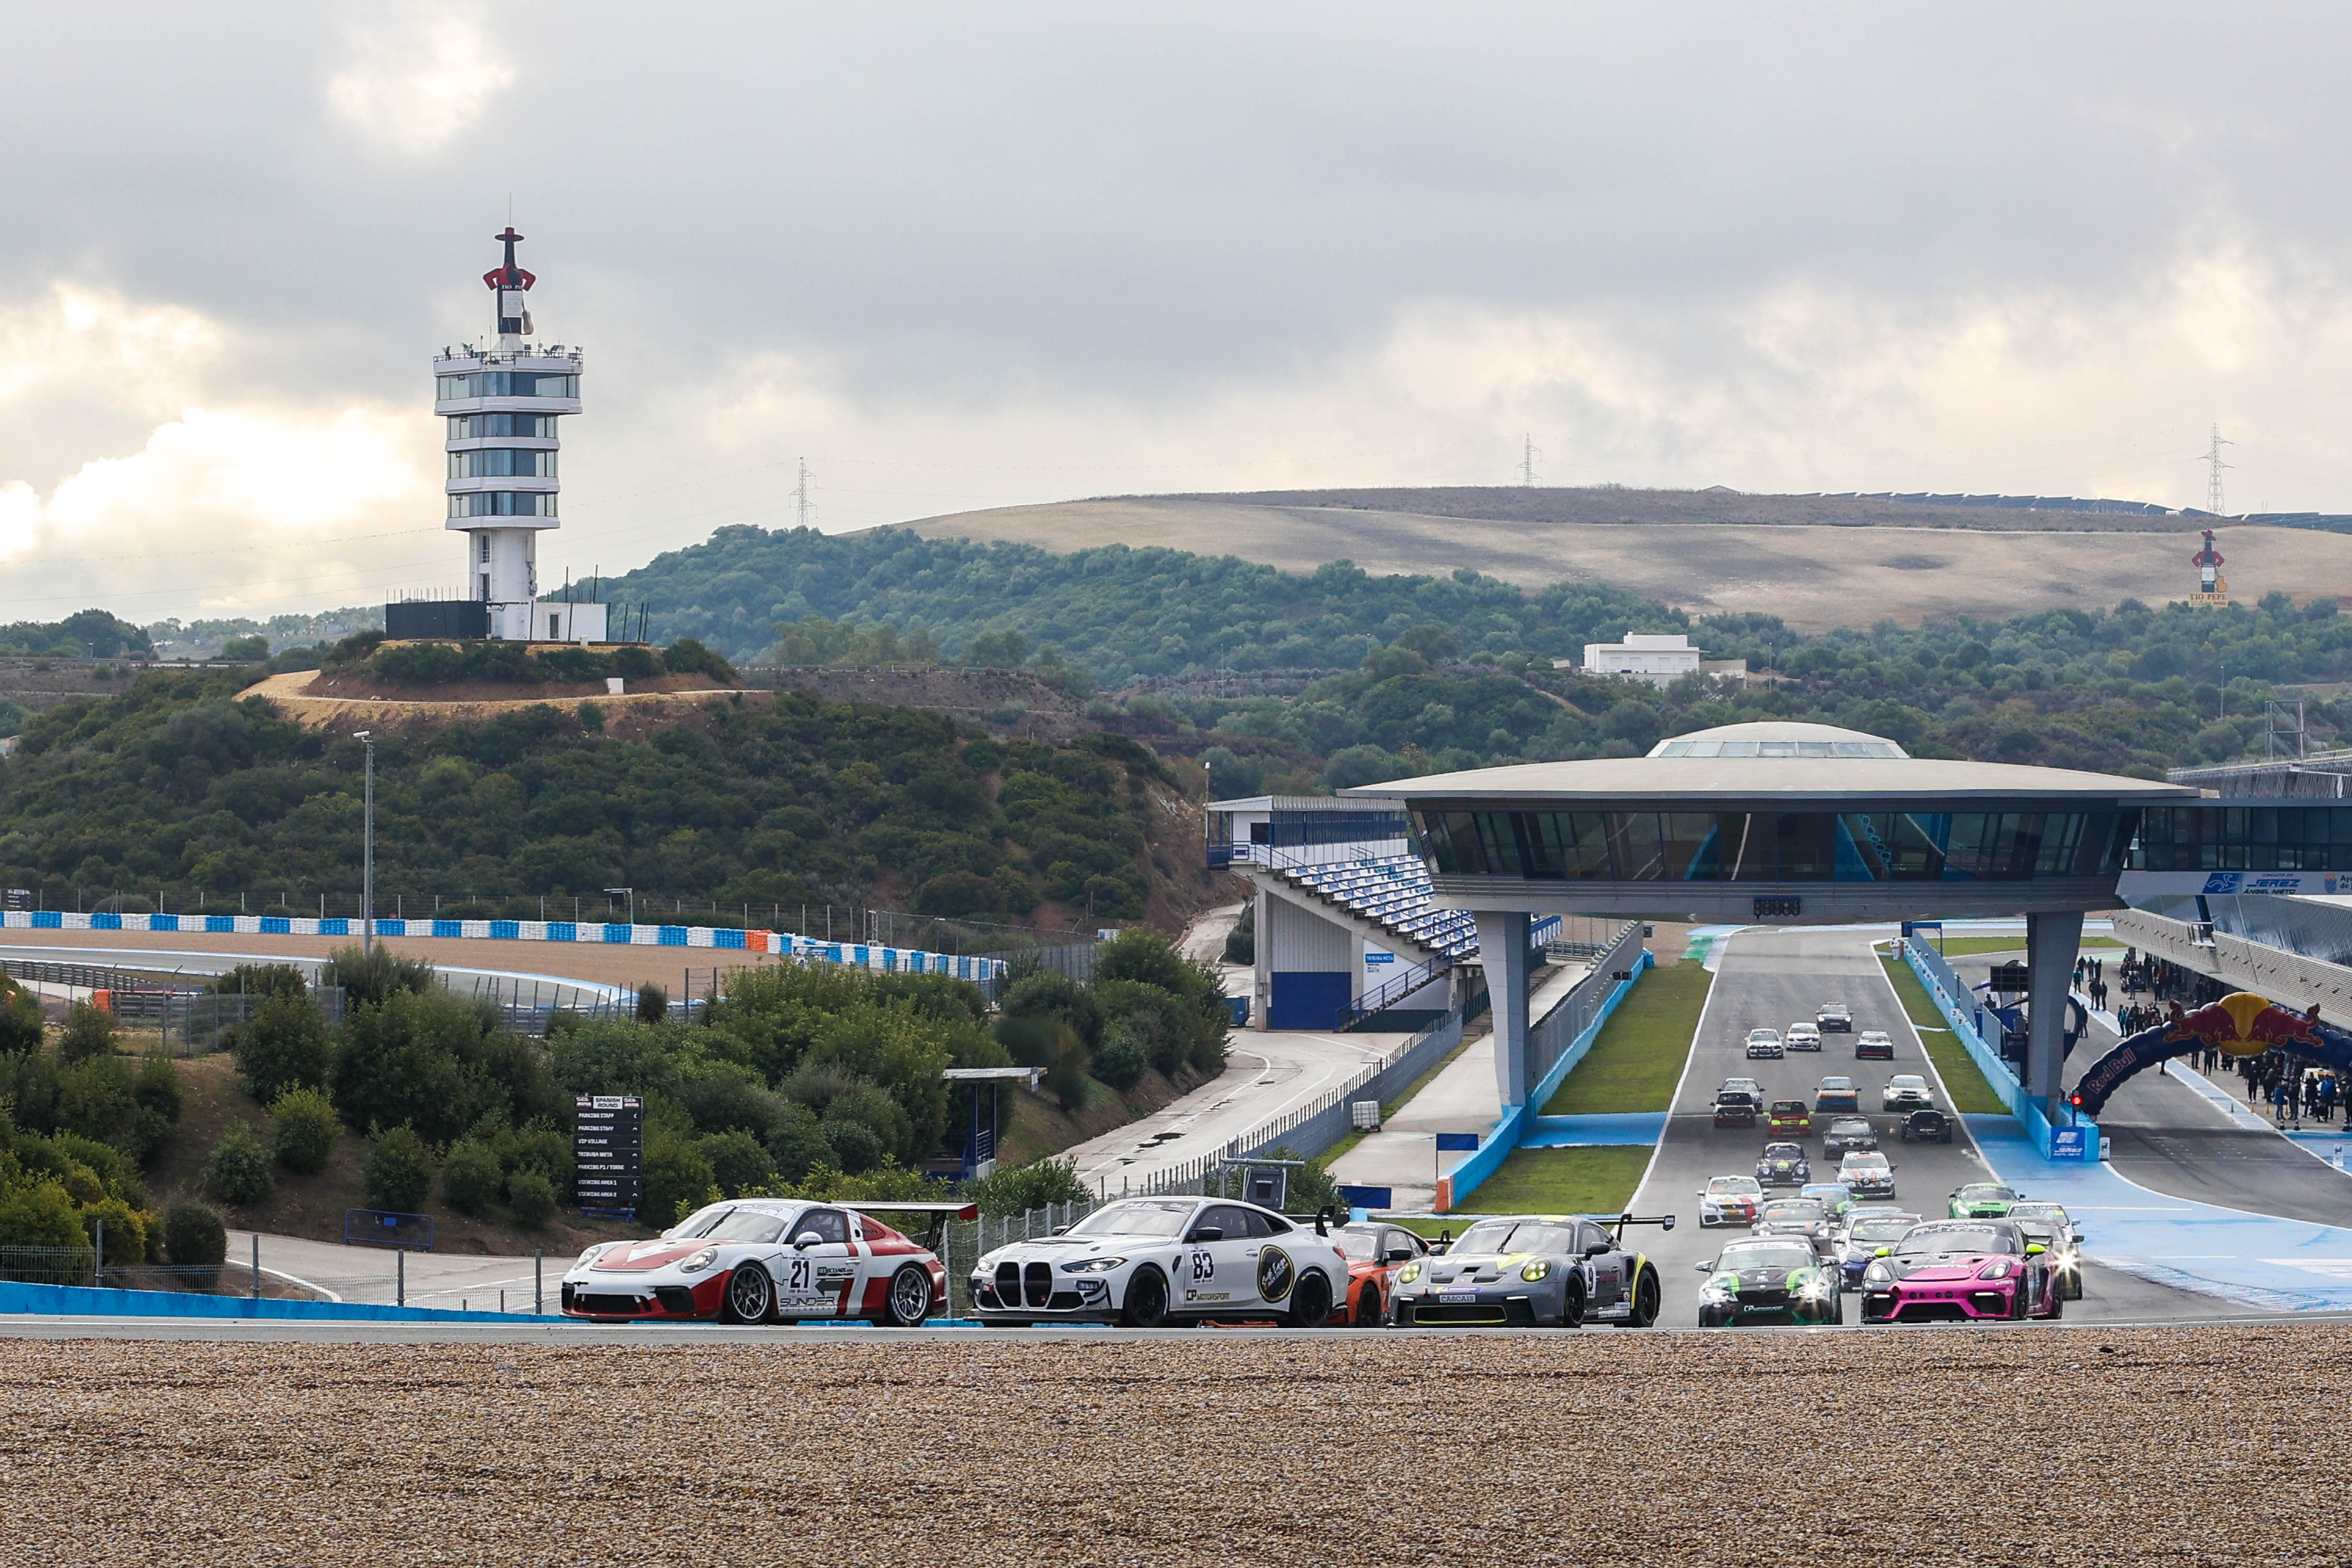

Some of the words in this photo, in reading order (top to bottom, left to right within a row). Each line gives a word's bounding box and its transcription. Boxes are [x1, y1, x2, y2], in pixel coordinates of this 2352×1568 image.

[2087, 1065, 2115, 1094] Red
[2108, 1047, 2137, 1074] Bull
[1912, 1224, 1997, 1233] SUNDER
[790, 1260, 810, 1288] 21
[1192, 1252, 1214, 1279] 83
[1588, 1267, 1594, 1292] 9
[780, 1297, 835, 1306] SUNDER
[1186, 1289, 1197, 1300] CP
